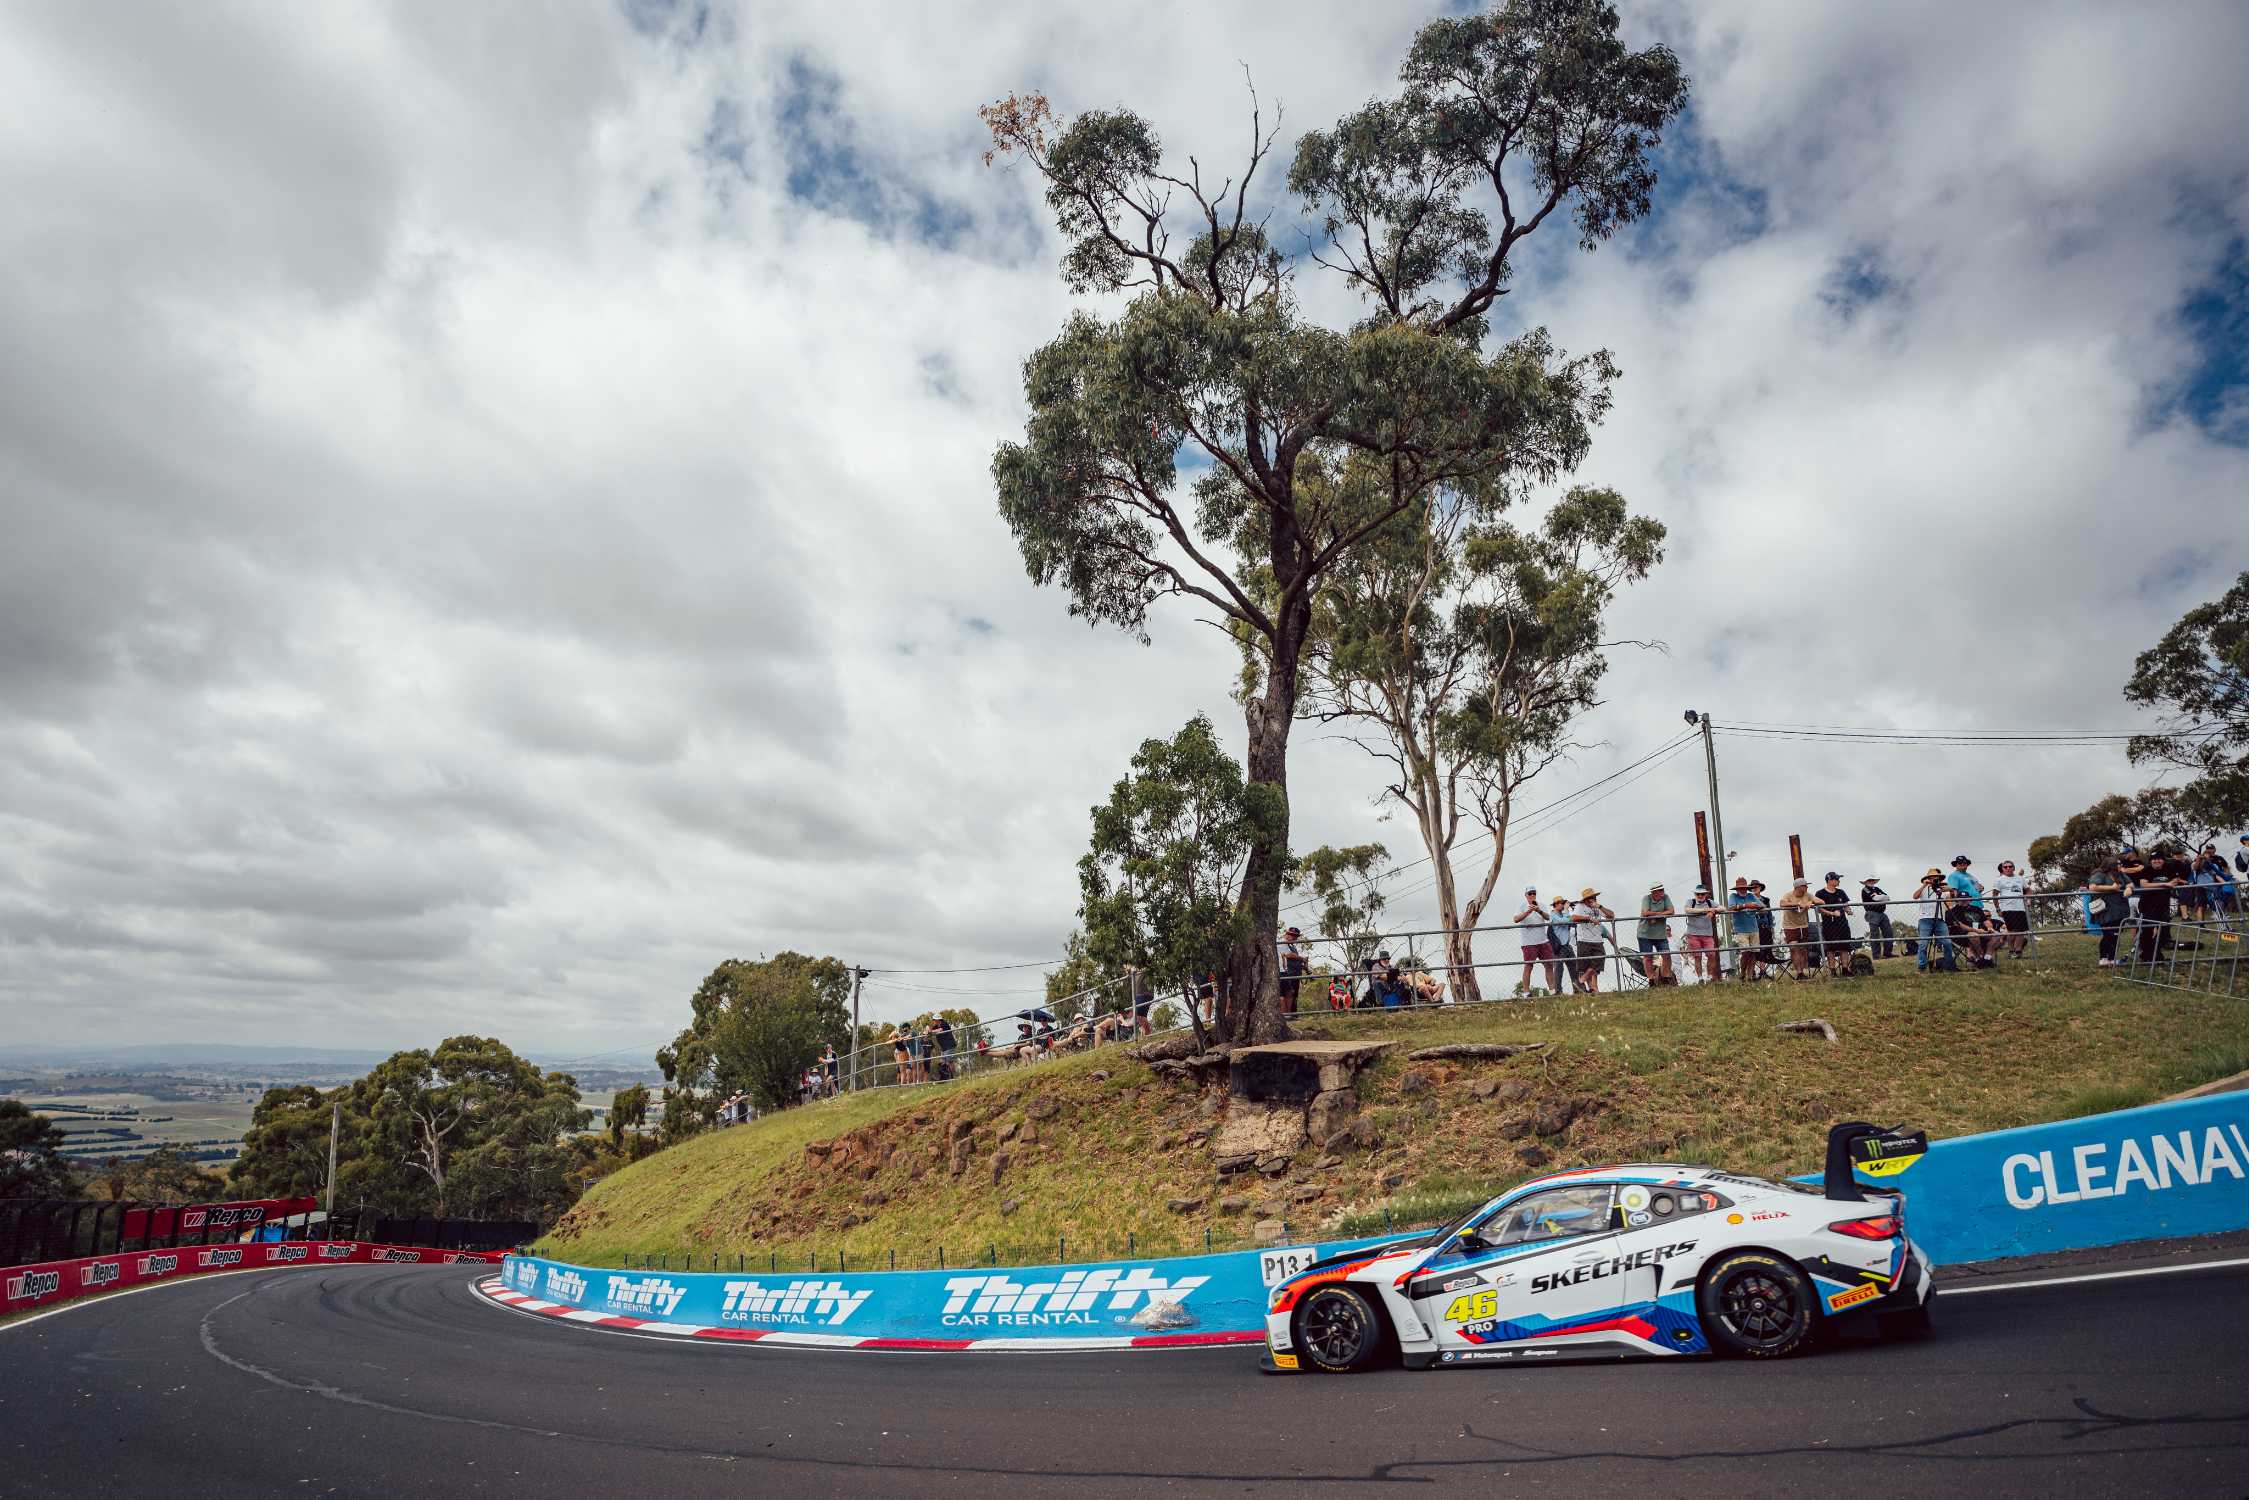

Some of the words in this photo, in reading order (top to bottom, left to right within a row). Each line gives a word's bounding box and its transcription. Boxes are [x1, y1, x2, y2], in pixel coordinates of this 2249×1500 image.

[2002, 1124, 2249, 1210] CLEANA
[209, 1206, 264, 1226] Repco
[1752, 1211, 1791, 1221] HELIX
[210, 1249, 243, 1267] Repco
[278, 1245, 308, 1262] Repco
[327, 1244, 351, 1259] Repco
[384, 1248, 421, 1264] Repco
[91, 1262, 120, 1286] Repco
[148, 1254, 178, 1276] Repco
[1530, 1239, 1699, 1294] SKECHERS
[23, 1271, 60, 1300] Repco
[546, 1267, 588, 1303] Thrifty
[942, 1268, 1211, 1321] Thrifty
[607, 1276, 687, 1316] Thrifty
[721, 1280, 873, 1325] Thrifty
[1445, 1289, 1498, 1323] 46
[623, 1303, 653, 1314] RENTAL
[721, 1311, 748, 1321] CAR
[752, 1312, 809, 1324] RENTAL
[942, 1313, 989, 1326] CAR
[997, 1311, 1099, 1325] RENTAL
[1467, 1321, 1493, 1334] PRO
